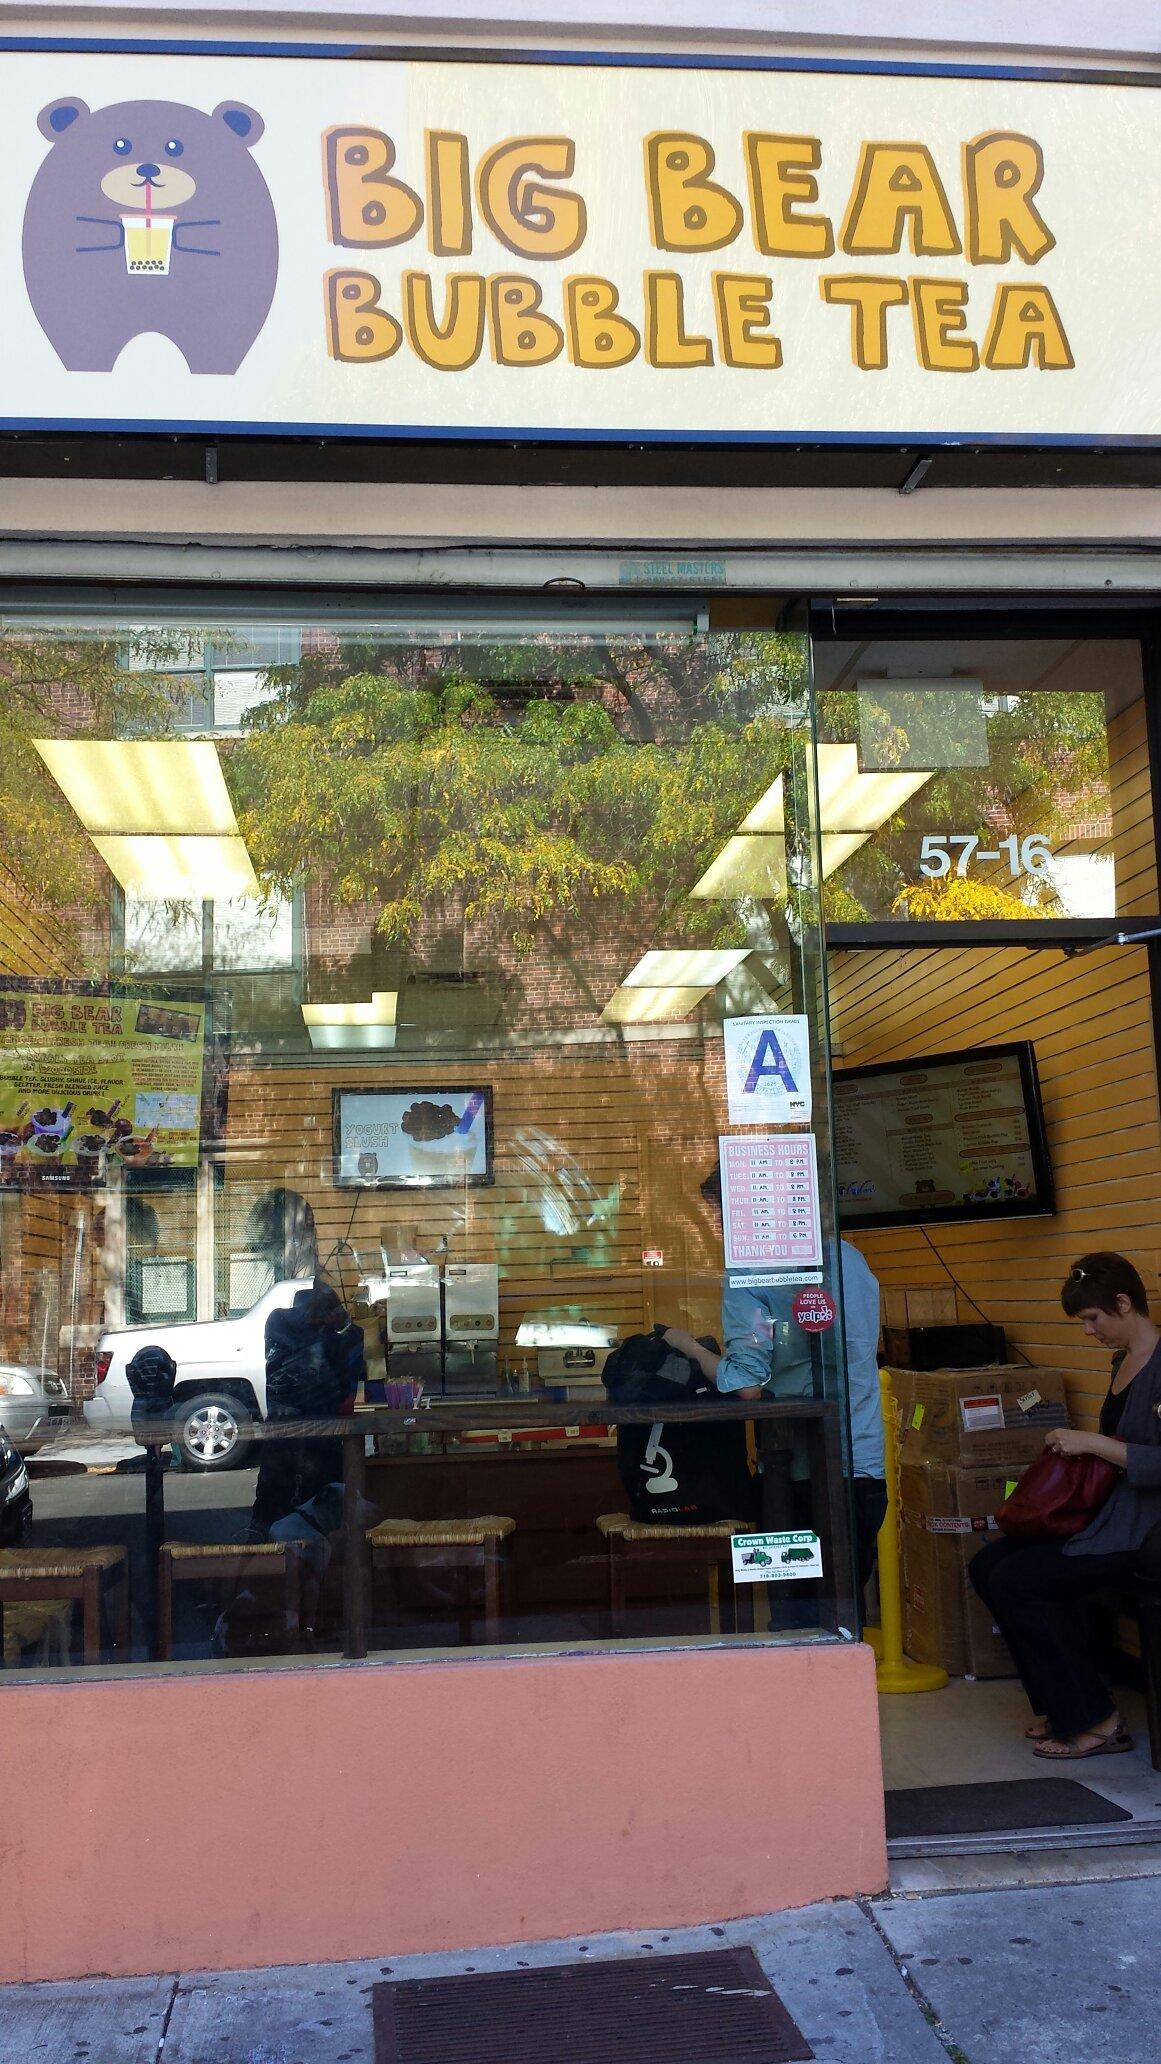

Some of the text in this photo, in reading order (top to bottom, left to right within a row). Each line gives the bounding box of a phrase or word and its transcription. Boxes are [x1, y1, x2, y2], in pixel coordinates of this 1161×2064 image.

[321, 123, 1057, 266] BIG BEAR
[322, 267, 1076, 373] BUBBLE TEA
[643, 560, 725, 575] STEEL MASTERS
[919, 833, 1053, 878] 57-16
[31, 1002, 123, 1023] BIG BEAR
[31, 1018, 123, 1035] BUBBLE TEA
[756, 1018, 784, 1026] INSPECTION
[742, 1029, 799, 1095] A
[65, 1083, 92, 1091] BLENDED
[100, 1078, 124, 1086] FLAVOR
[344, 1122, 399, 1136] YOGURT
[344, 1136, 389, 1149] SLUSH
[728, 1143, 809, 1157] BUSINESS HOURS
[730, 1275, 819, 1286] www.bigbearbubbletea.com
[797, 1309, 822, 1324] yelp
[737, 1538, 764, 1547] Crown
[765, 1536, 791, 1545] Waste
[792, 1534, 813, 1544] Corp
